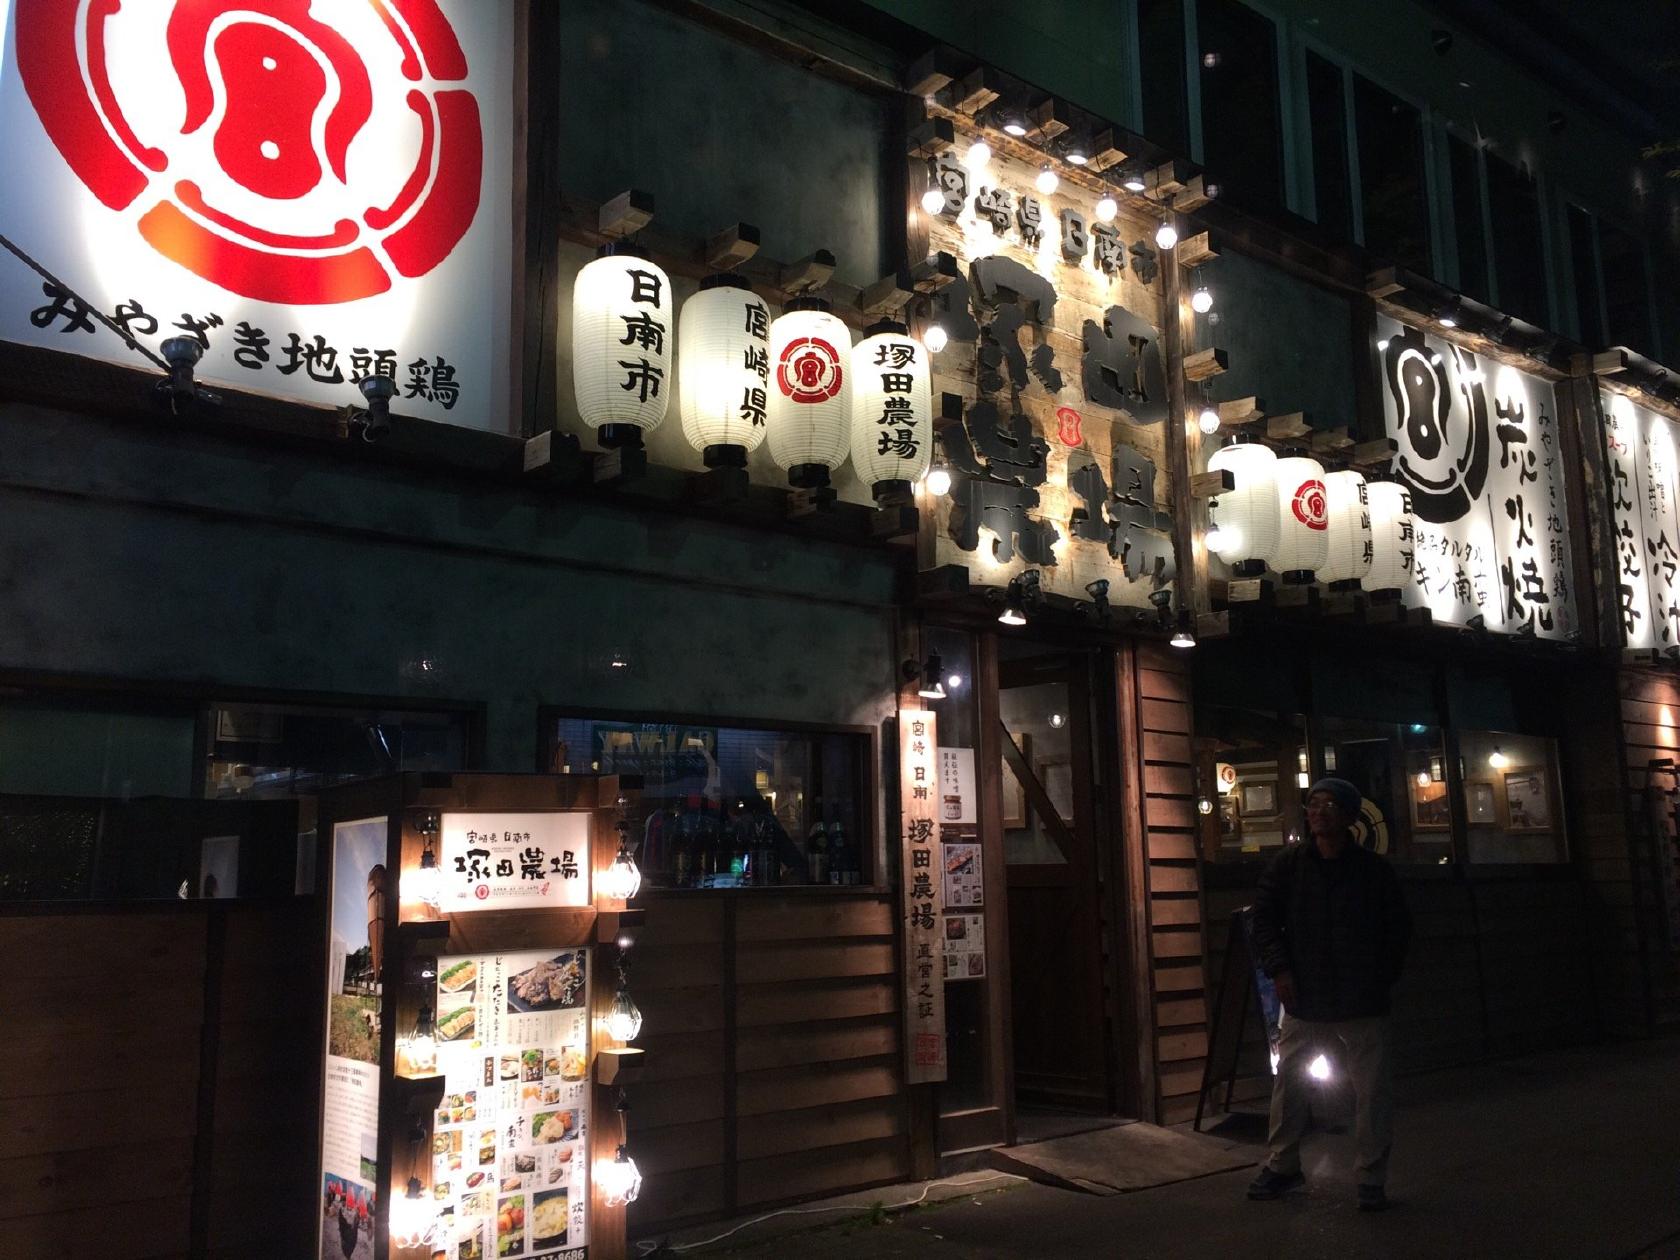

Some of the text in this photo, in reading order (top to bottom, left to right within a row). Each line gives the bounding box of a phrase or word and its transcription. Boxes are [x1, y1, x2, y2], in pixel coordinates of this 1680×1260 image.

[29, 281, 460, 410] みやざき地頭鶏
[618, 267, 667, 403] 日南市
[740, 301, 771, 427] 宮崎県
[873, 343, 920, 460] 塚田農場
[1495, 394, 1554, 633] 炭火焼
[454, 847, 579, 884] 塚田農場
[907, 817, 936, 931] 塚田農場
